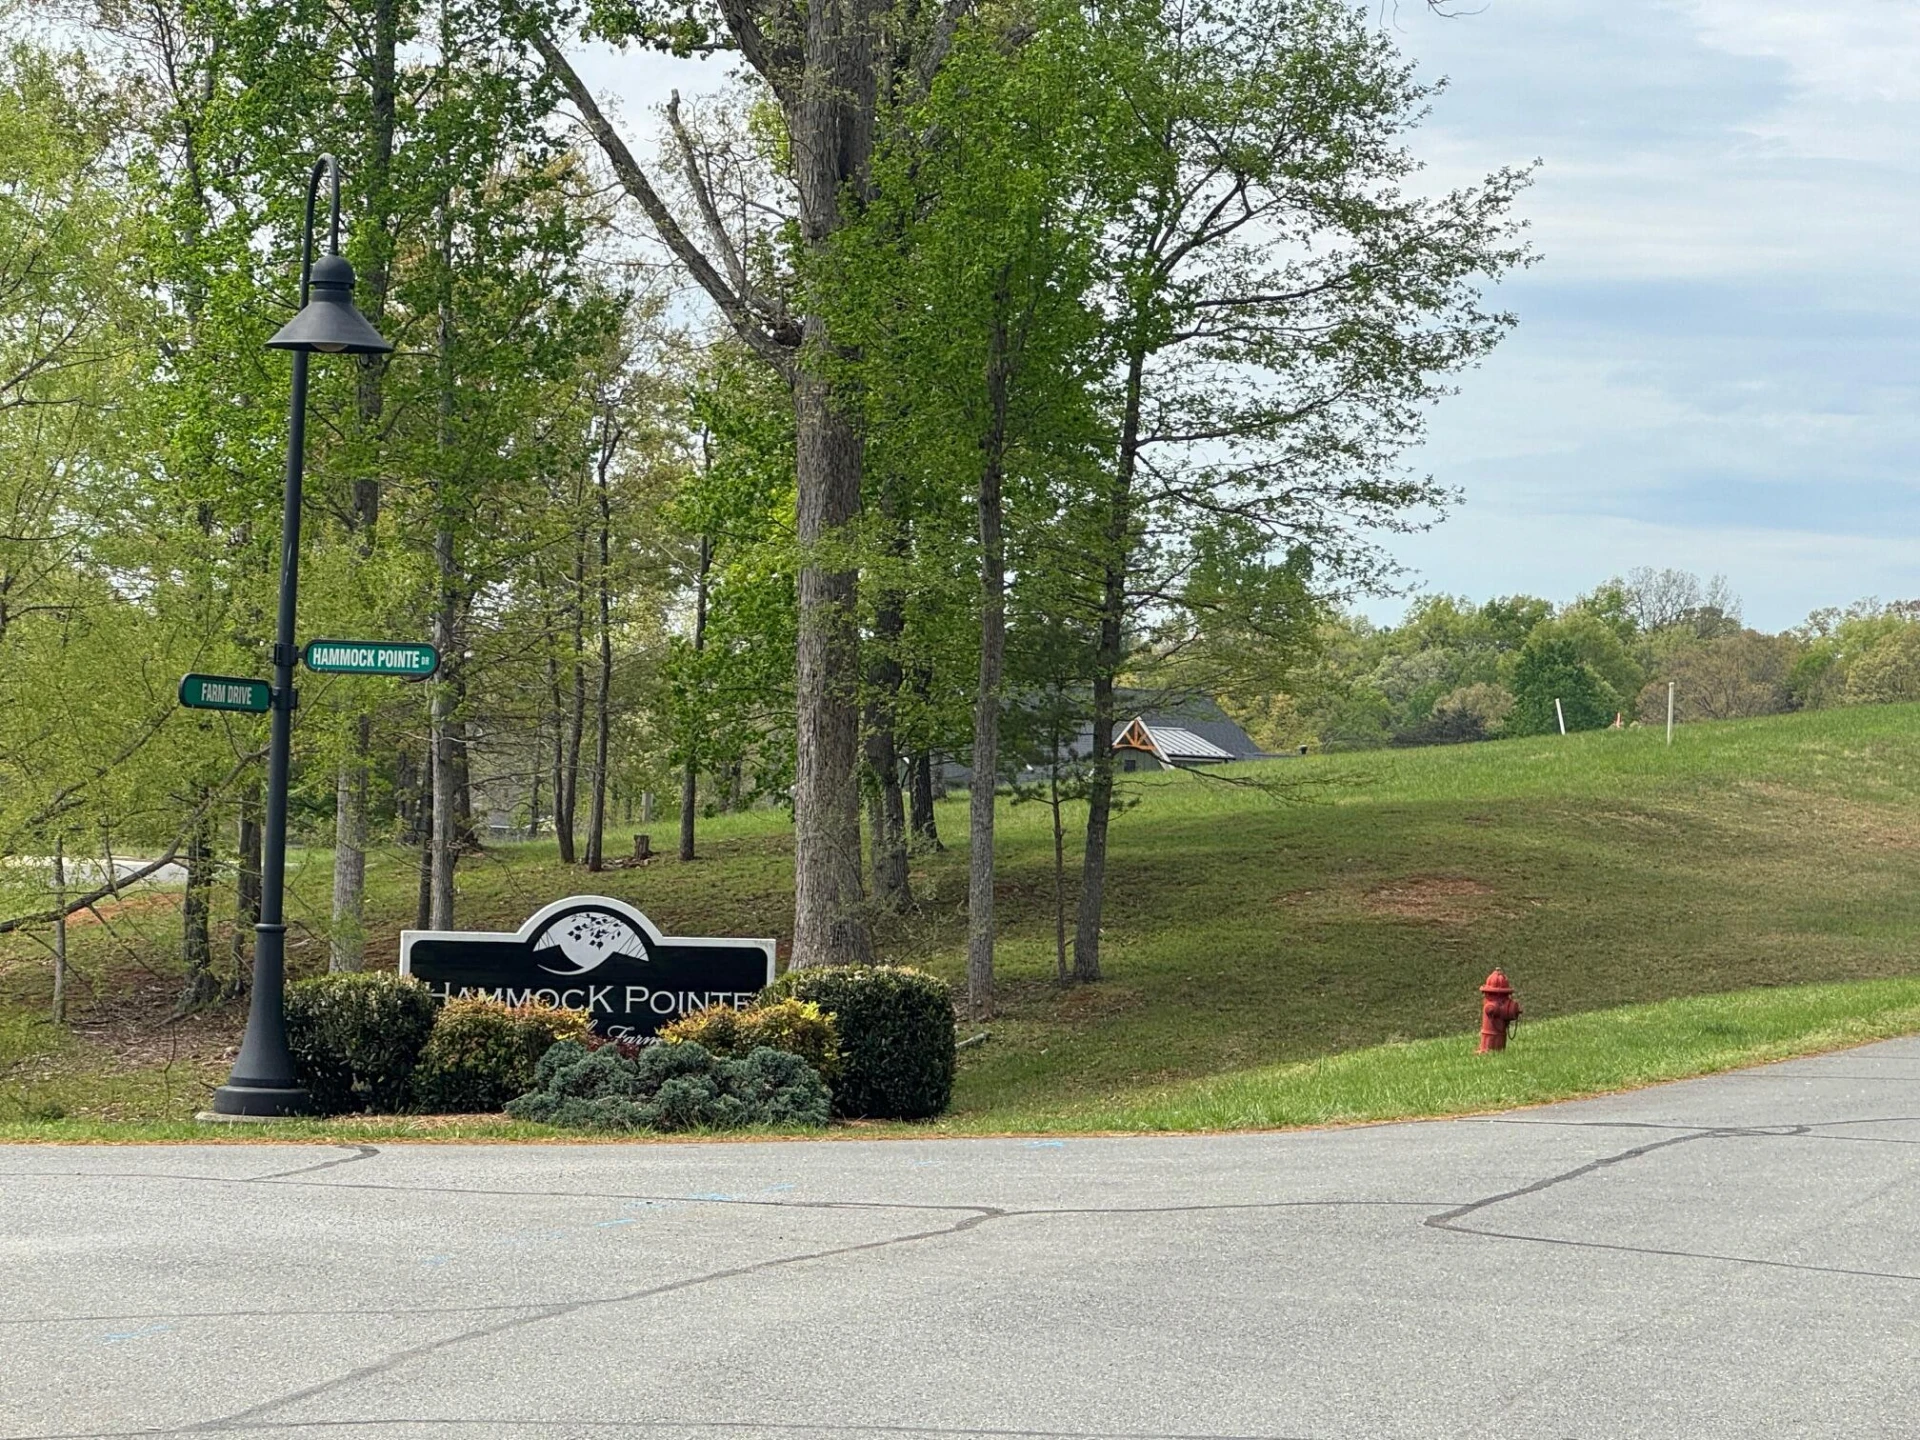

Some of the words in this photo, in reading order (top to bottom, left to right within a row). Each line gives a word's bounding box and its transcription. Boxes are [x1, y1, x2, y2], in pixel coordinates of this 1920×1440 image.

[312, 647, 376, 667] HAMMOCK
[377, 649, 420, 668] POINTE
[421, 656, 430, 665] DR
[201, 682, 226, 702] FARM
[227, 685, 252, 705] DRIVE
[625, 985, 755, 1014] POINTE
